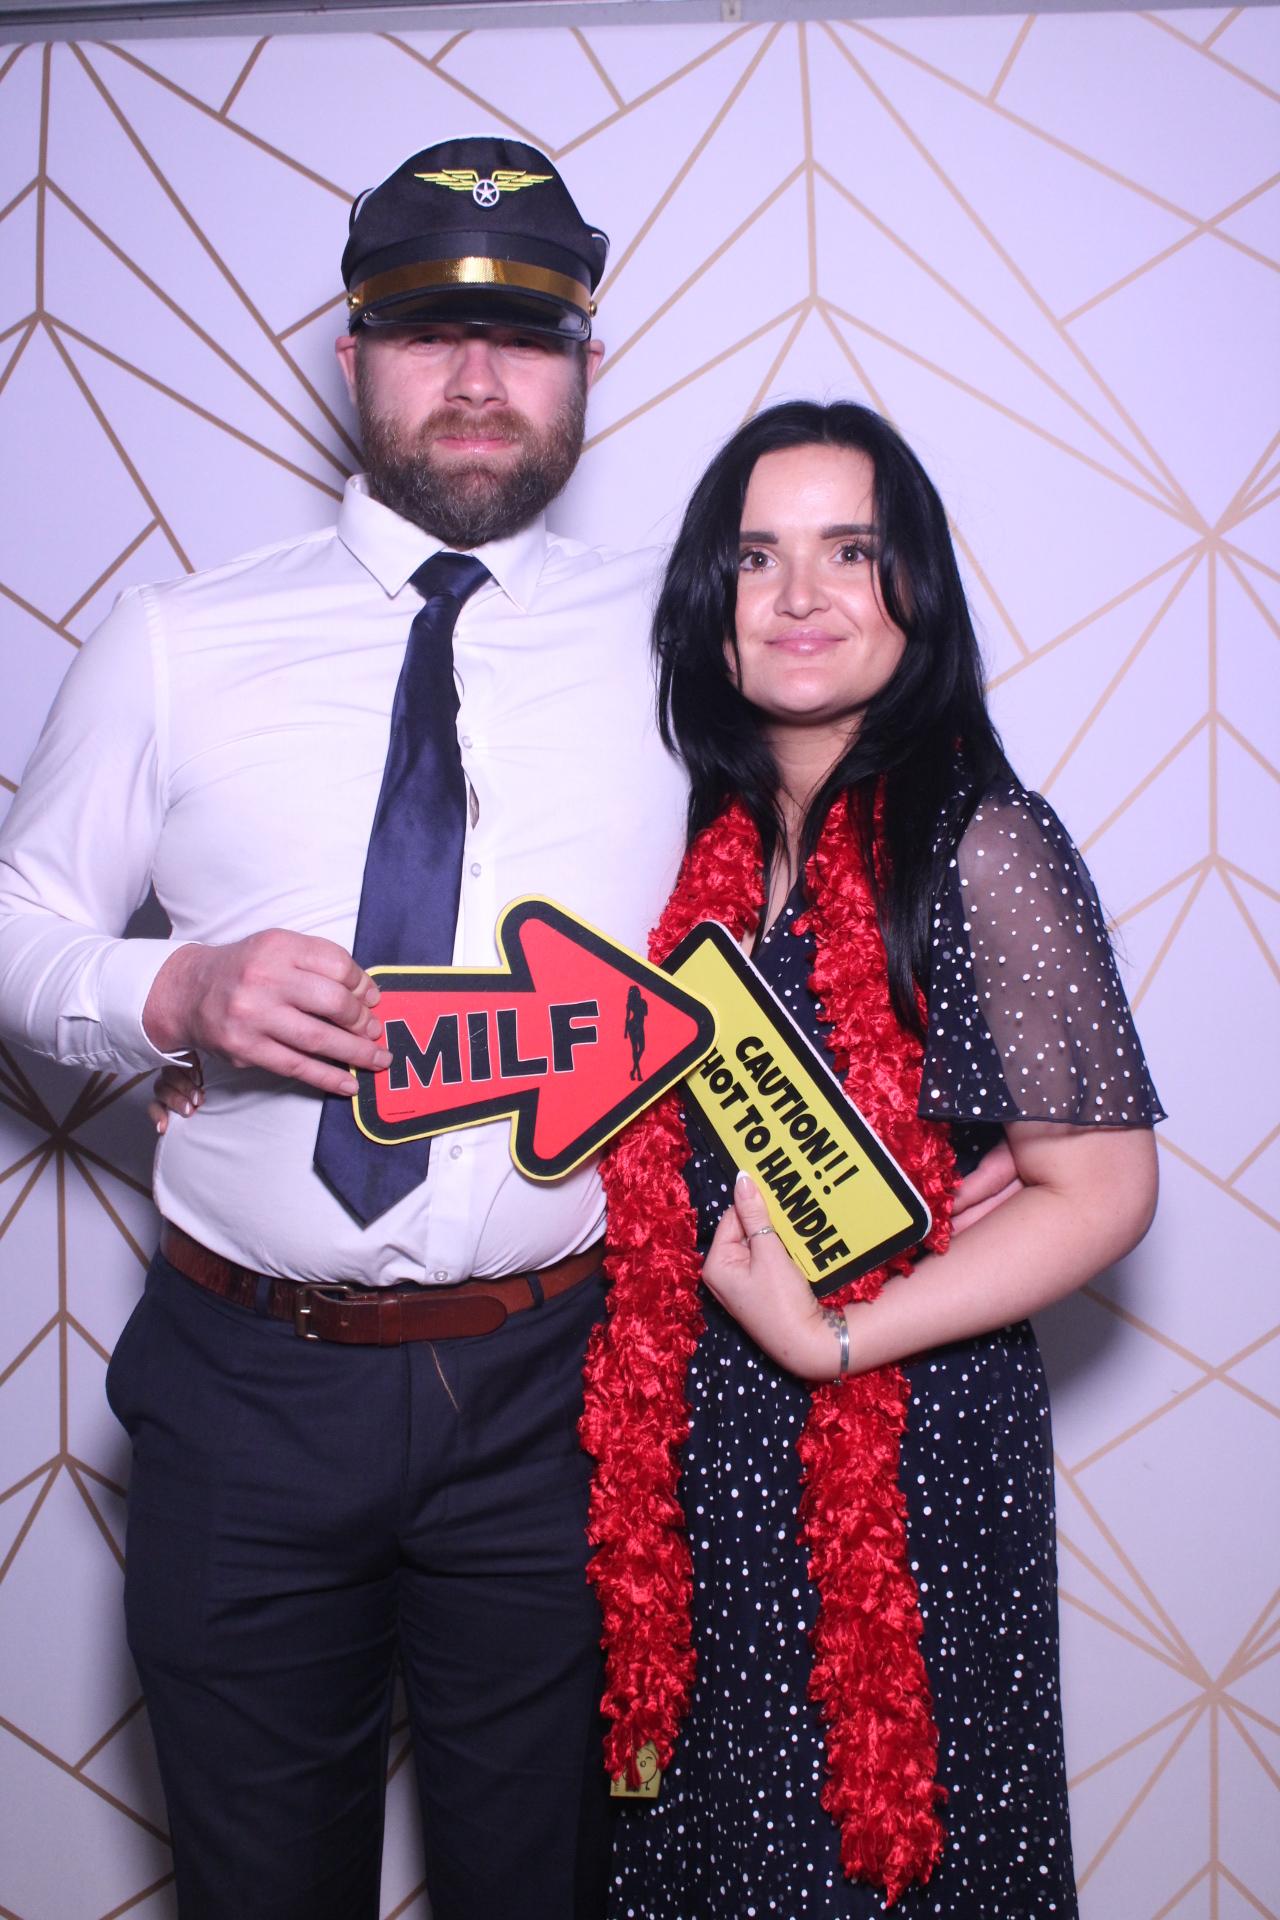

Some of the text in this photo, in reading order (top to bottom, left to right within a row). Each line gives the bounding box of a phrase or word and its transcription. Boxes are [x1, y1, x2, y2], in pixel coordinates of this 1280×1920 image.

[385, 999, 601, 1091] MILF
[735, 1036, 859, 1195] CAUTION!!
[699, 1047, 851, 1272] HOT TO HANDLE
